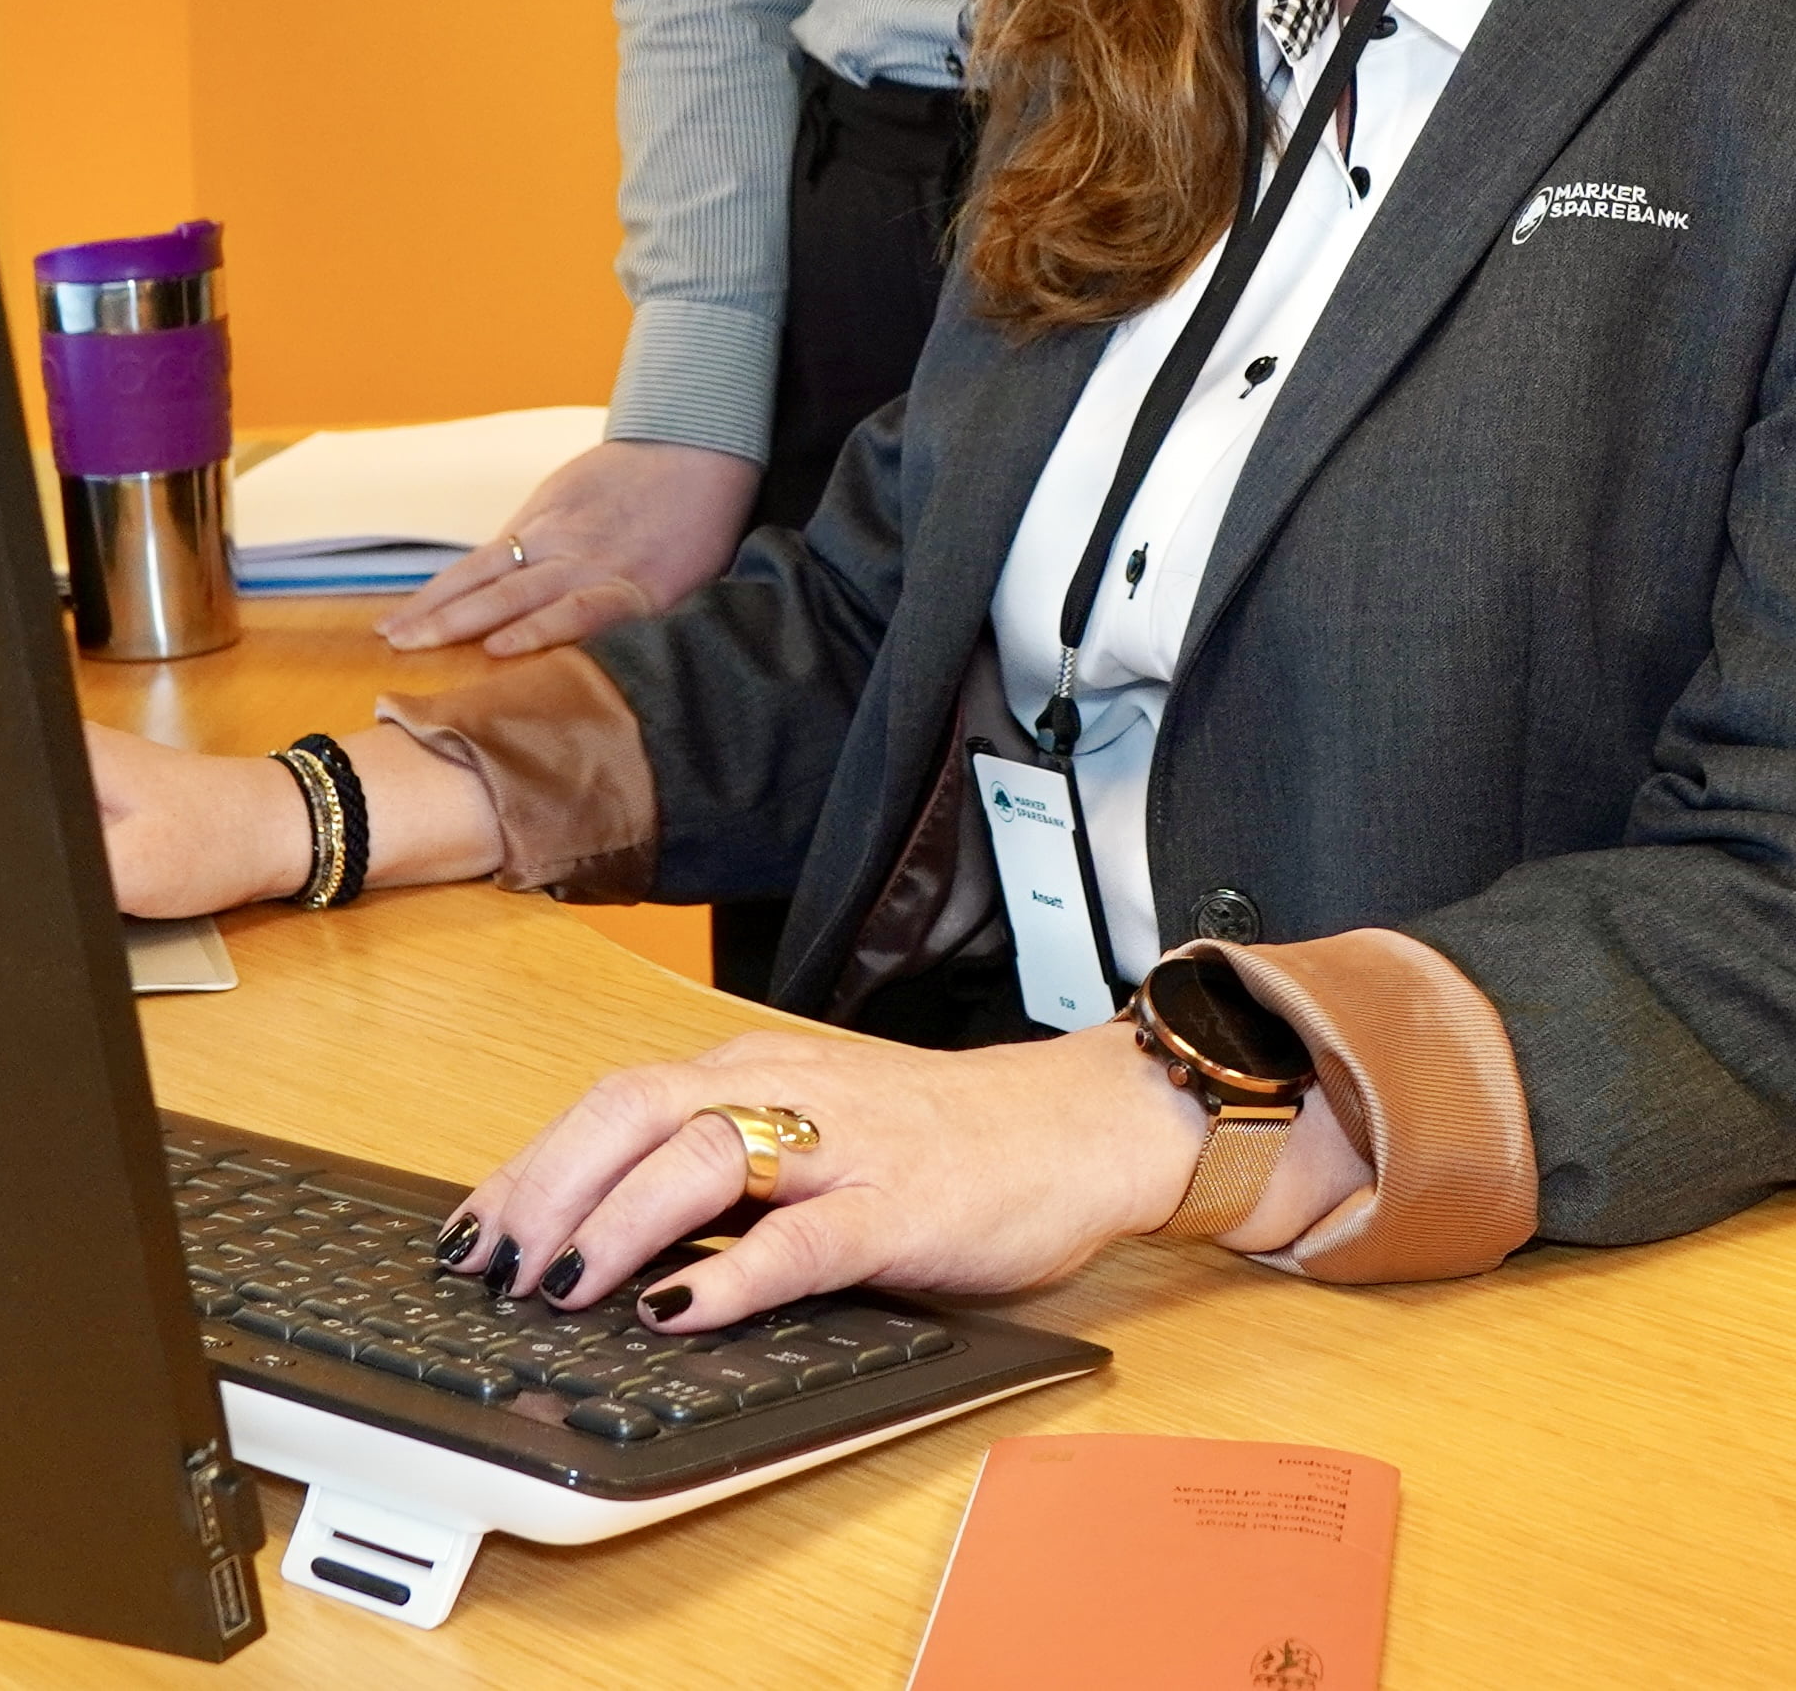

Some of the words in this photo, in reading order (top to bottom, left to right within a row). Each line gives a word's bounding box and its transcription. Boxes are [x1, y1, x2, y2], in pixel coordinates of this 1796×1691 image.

[1553, 182, 1648, 205] MARKER
[1549, 200, 1690, 230] SPAREBANK
[1014, 796, 1046, 811] MARKER
[1016, 808, 1066, 829] SPAREBANK
